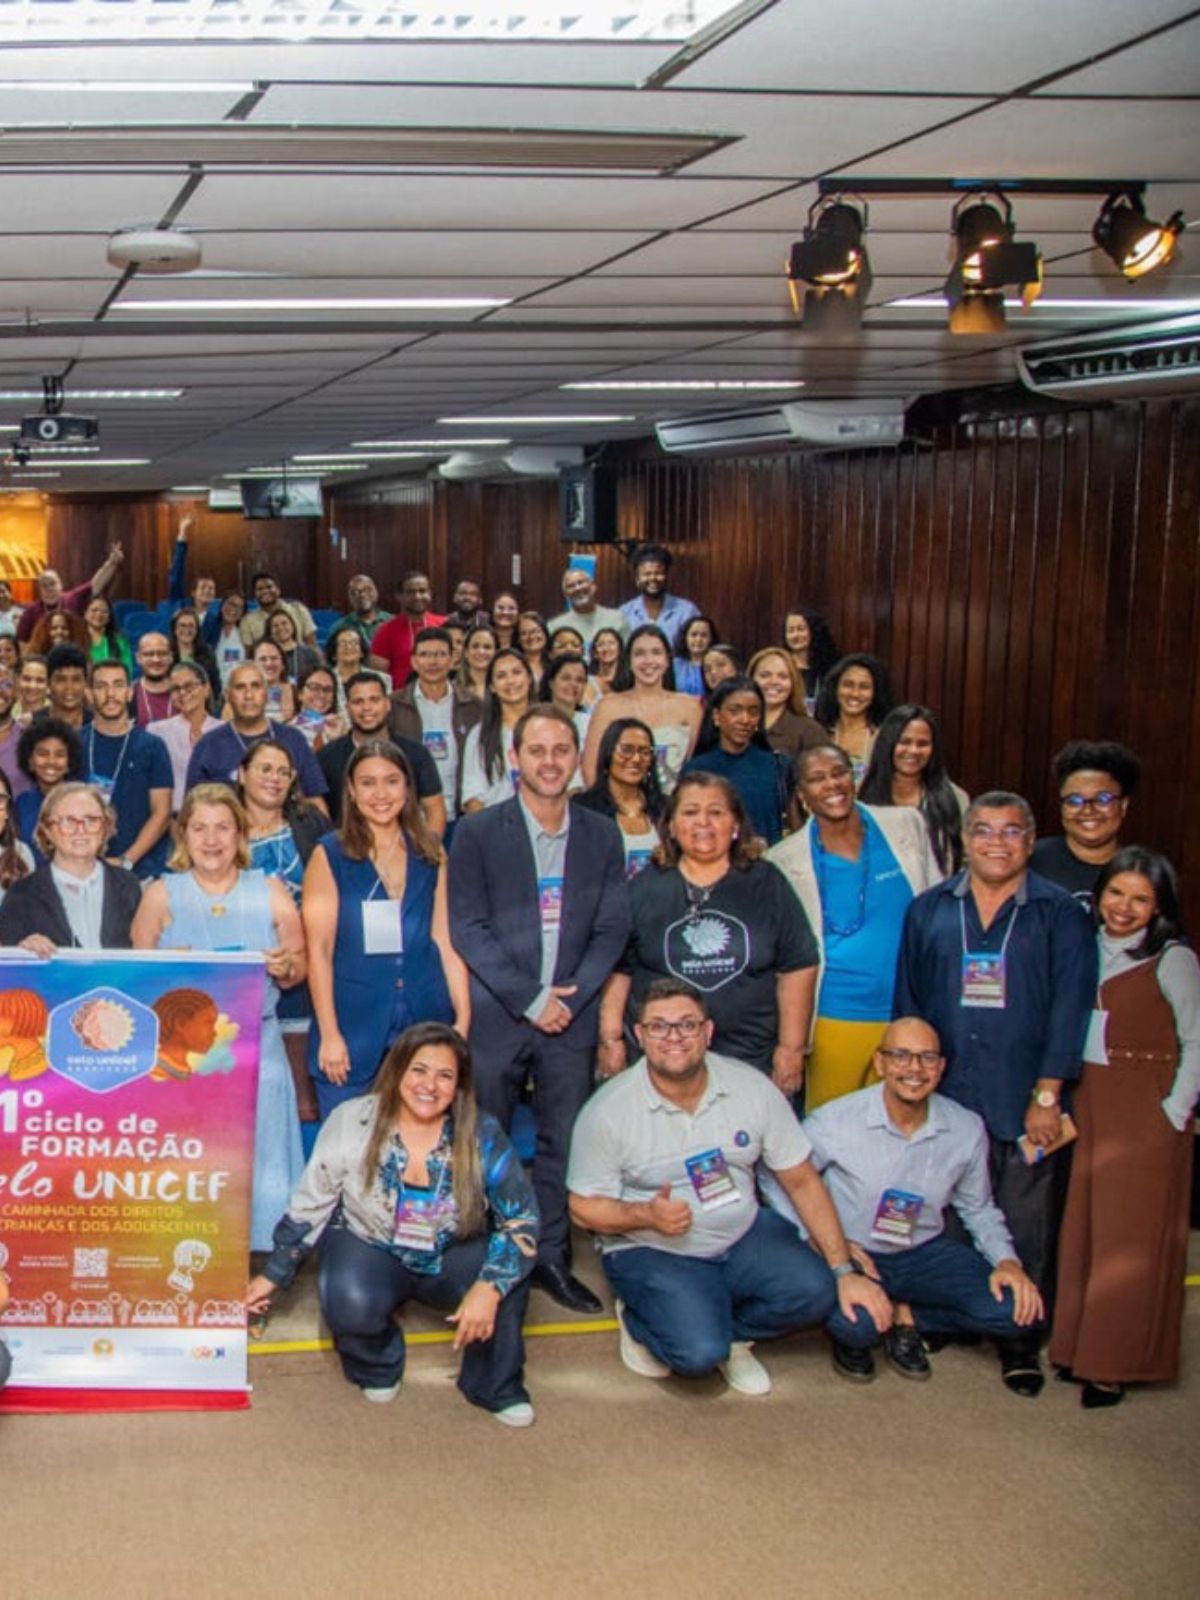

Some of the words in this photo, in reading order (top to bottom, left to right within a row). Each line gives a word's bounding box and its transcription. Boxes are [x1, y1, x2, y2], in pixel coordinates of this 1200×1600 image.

[24, 1110, 104, 1133] ciclo
[117, 1113, 158, 1134] de
[20, 1133, 204, 1163] FORMAÇÃO
[73, 1168, 231, 1203] UNICEF
[1, 1203, 85, 1218] CAMINHADA
[89, 1204, 120, 1218] DOS
[123, 1204, 185, 1219] DIREITOS
[68, 1220, 77, 1233] E
[81, 1220, 110, 1233] DOS
[113, 1220, 220, 1235] ADOLESCENTES
